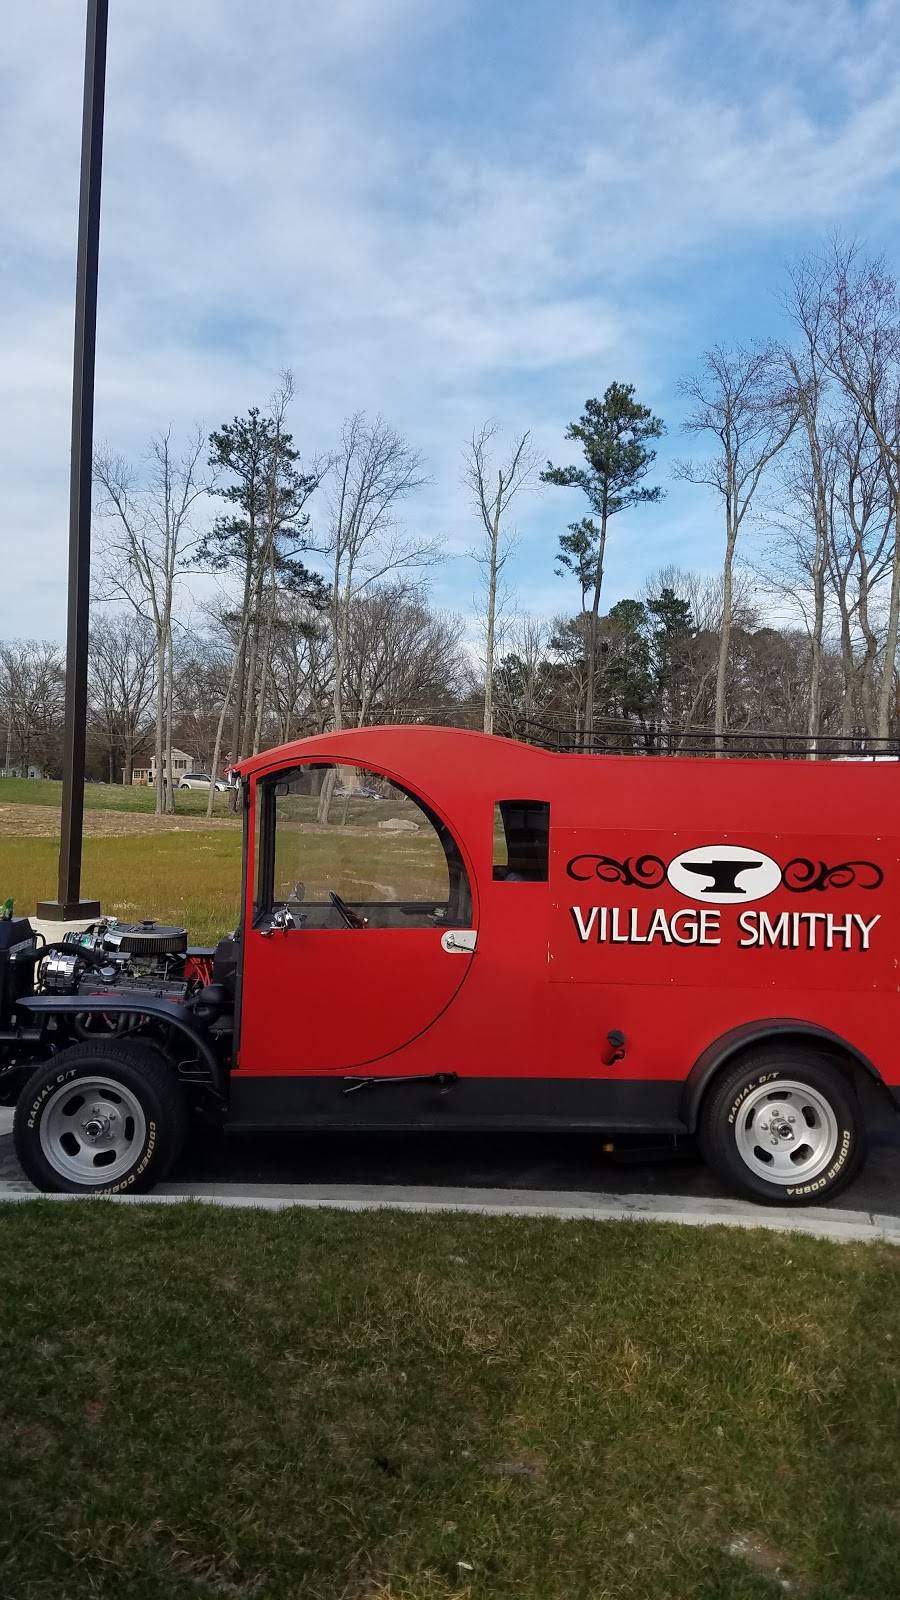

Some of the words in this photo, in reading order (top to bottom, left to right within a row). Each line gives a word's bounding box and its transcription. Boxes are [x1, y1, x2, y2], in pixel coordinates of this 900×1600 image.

[572, 906, 721, 944] VILLAGE
[738, 910, 882, 949] SMITHY
[27, 1084, 55, 1128] RADIAL
[728, 1083, 756, 1124] RADIAL
[136, 1121, 157, 1174] COOPER
[828, 1130, 851, 1179] COOPER
[786, 1178, 827, 1196] COBRA
